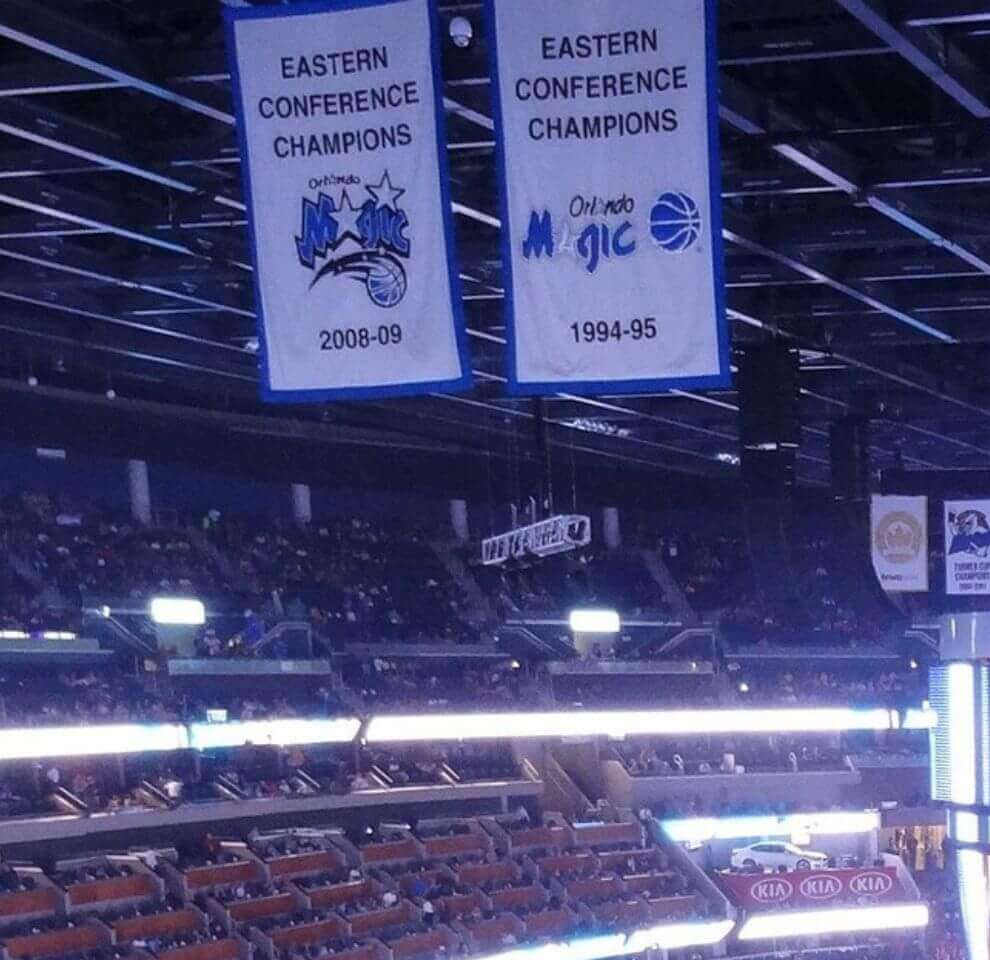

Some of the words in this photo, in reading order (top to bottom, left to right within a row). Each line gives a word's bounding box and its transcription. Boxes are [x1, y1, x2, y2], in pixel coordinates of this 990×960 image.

[541, 29, 658, 60] EASTERN
[280, 46, 389, 80] EASTERN
[515, 67, 688, 101] CONFERENCE
[258, 81, 419, 120] CONFERENCE
[528, 109, 679, 141] CHAMPIONS
[273, 124, 413, 159] CHAMPIONS
[569, 192, 635, 217] Orlando
[319, 325, 402, 351] 2008-09
[570, 318, 657, 344] 1994-95
